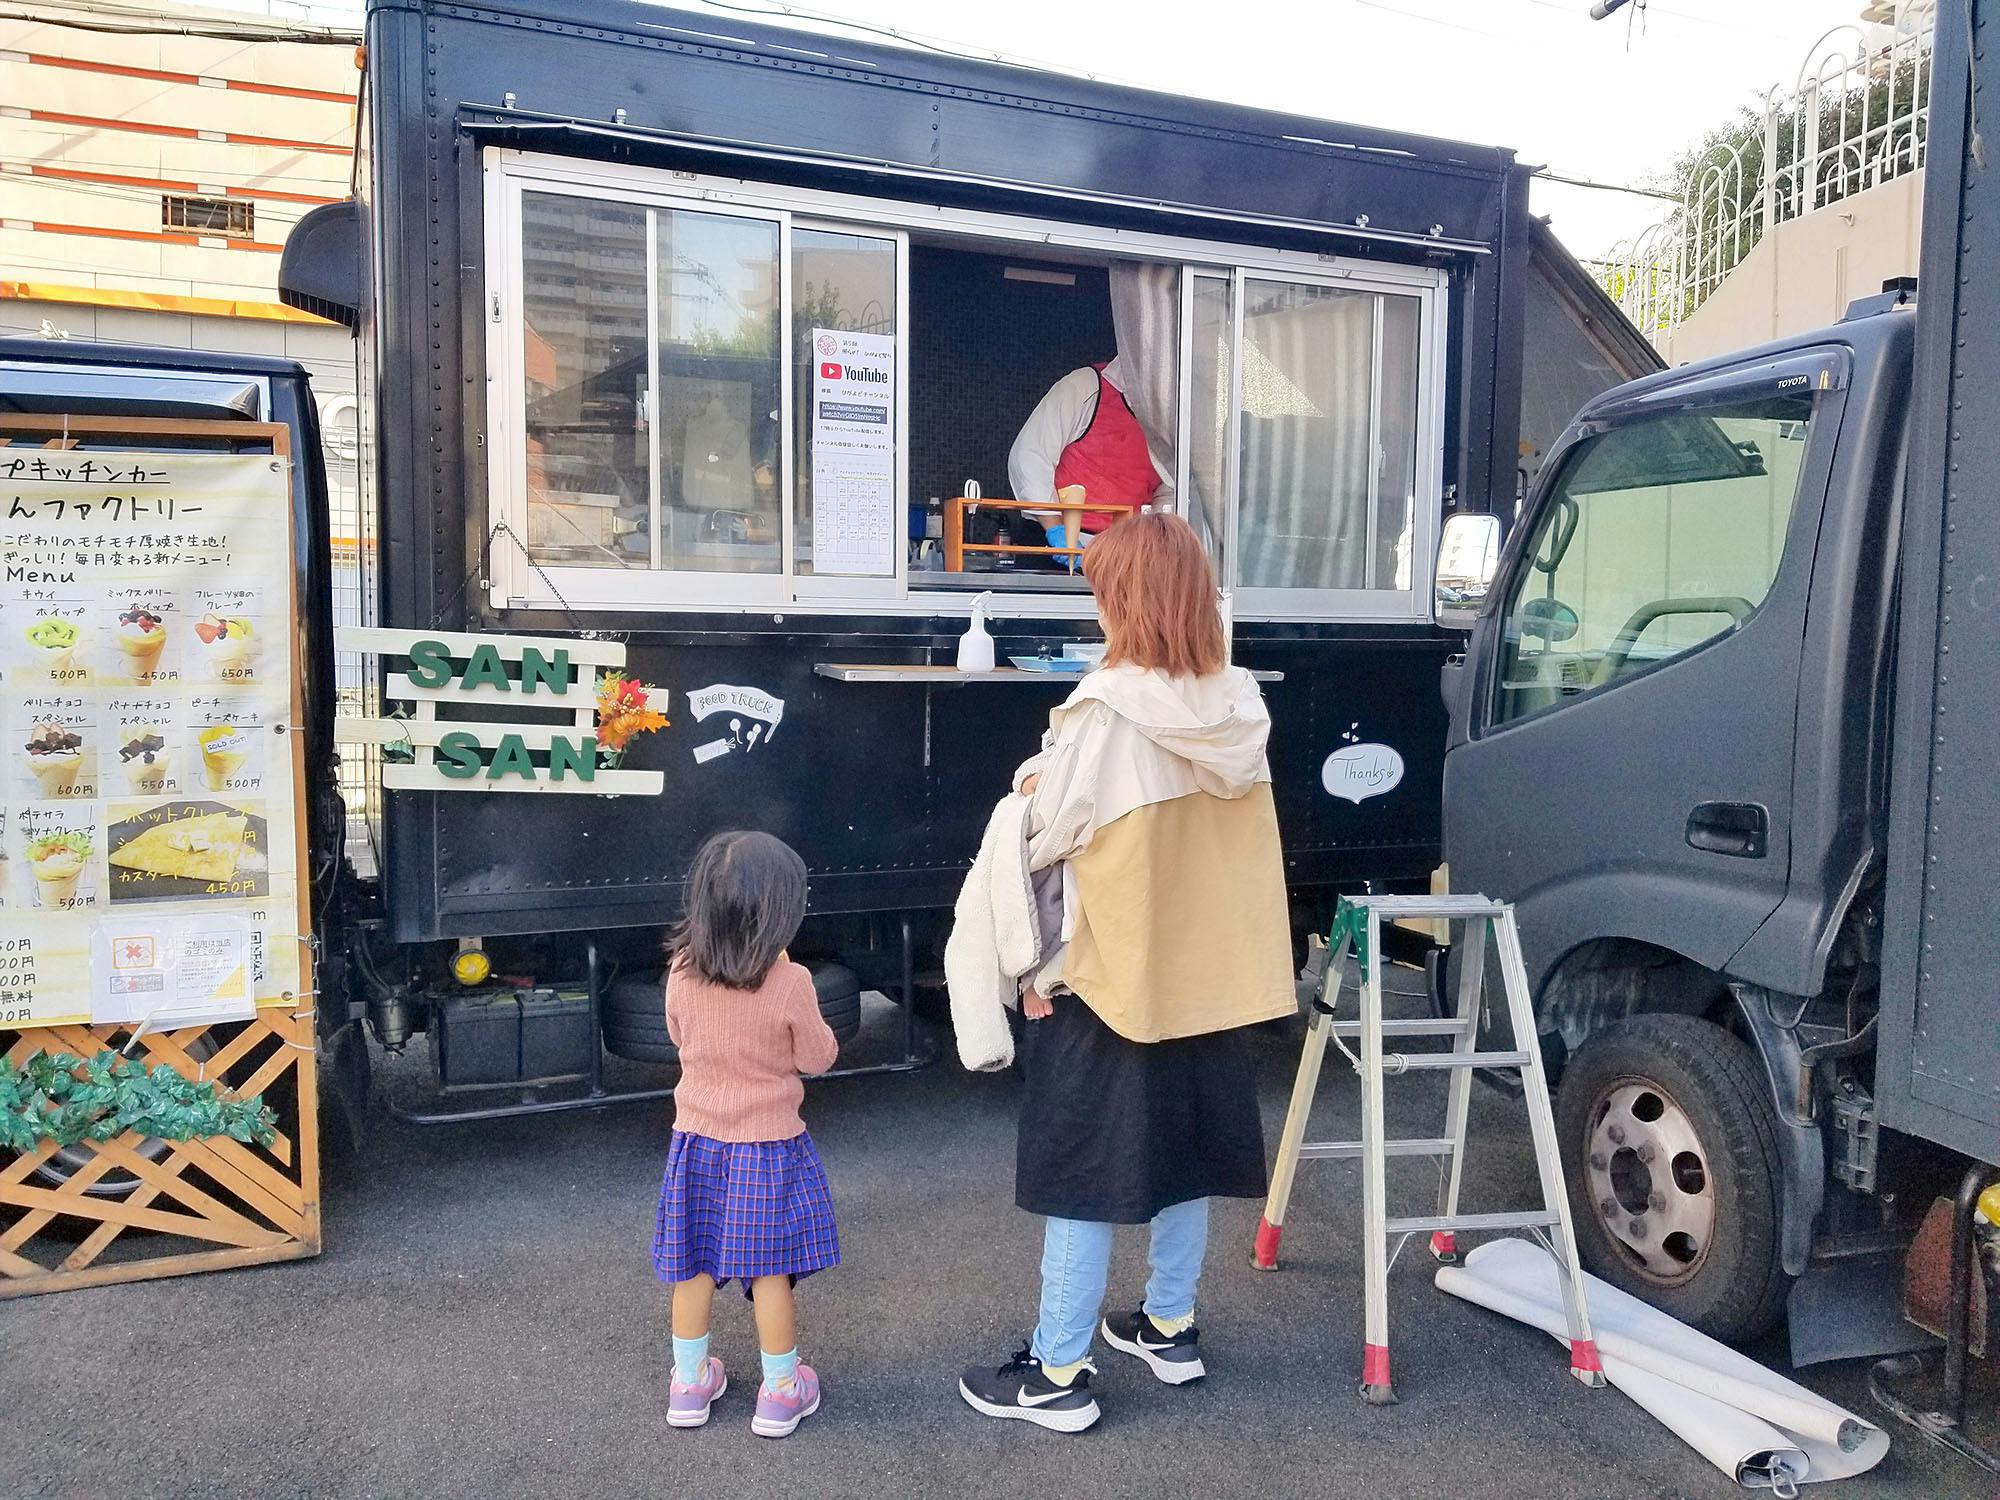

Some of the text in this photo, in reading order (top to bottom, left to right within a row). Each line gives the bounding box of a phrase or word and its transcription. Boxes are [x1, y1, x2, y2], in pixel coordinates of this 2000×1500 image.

[844, 365, 888, 384] YouTube
[1777, 376, 1808, 389] TOYOTA
[0, 457, 167, 483] プキッチンカー
[8, 495, 203, 521] んファクトリー
[6, 565, 76, 583] Menu
[22, 588, 55, 599] キウイ
[106, 588, 173, 598] ミックスベリー
[129, 602, 174, 611] ホイップ
[206, 601, 243, 609] クレープ
[36, 607, 85, 617] ホイップ
[406, 639, 569, 695] SAN
[50, 669, 87, 679] 500円
[141, 671, 178, 681] 450円
[221, 668, 254, 678] 650円
[23, 697, 82, 707] ベリーチョコ
[109, 699, 171, 710] バナナチョコ
[192, 698, 220, 707] ピーチ
[697, 692, 774, 713] FOOD TRUCK
[32, 714, 86, 724] スペシャル
[120, 716, 171, 725] スペシャル
[204, 712, 258, 722] チーズケーキ
[207, 741, 227, 751] SOLD
[437, 731, 598, 782] SAN
[141, 779, 176, 790] 550円
[226, 778, 260, 789] 500円
[57, 784, 93, 795] 600円
[18, 809, 64, 820] ポテサラ
[206, 880, 256, 894] 450円
[59, 896, 96, 908] 500円
[0, 938, 31, 952] 0円
[2, 990, 33, 1004] 無料
